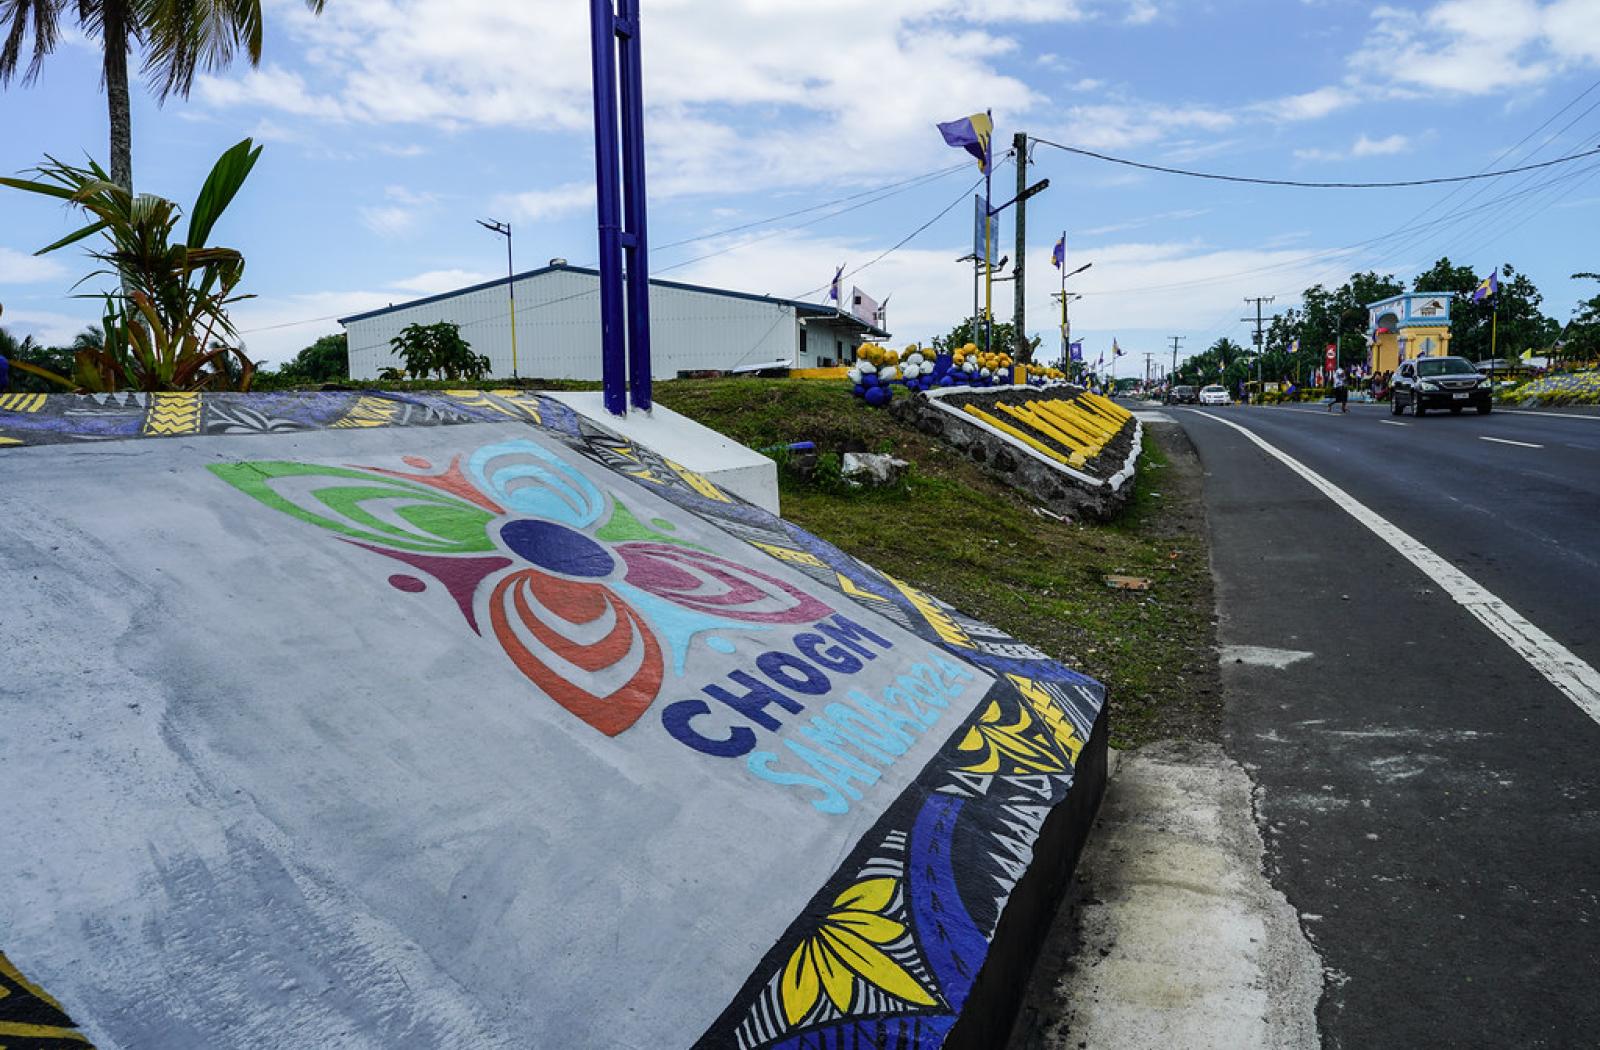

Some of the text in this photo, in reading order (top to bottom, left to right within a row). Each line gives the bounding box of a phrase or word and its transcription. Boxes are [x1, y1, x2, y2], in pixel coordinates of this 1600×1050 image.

[661, 614, 894, 759] CHOGM
[747, 651, 975, 815] SAMOA 2024
